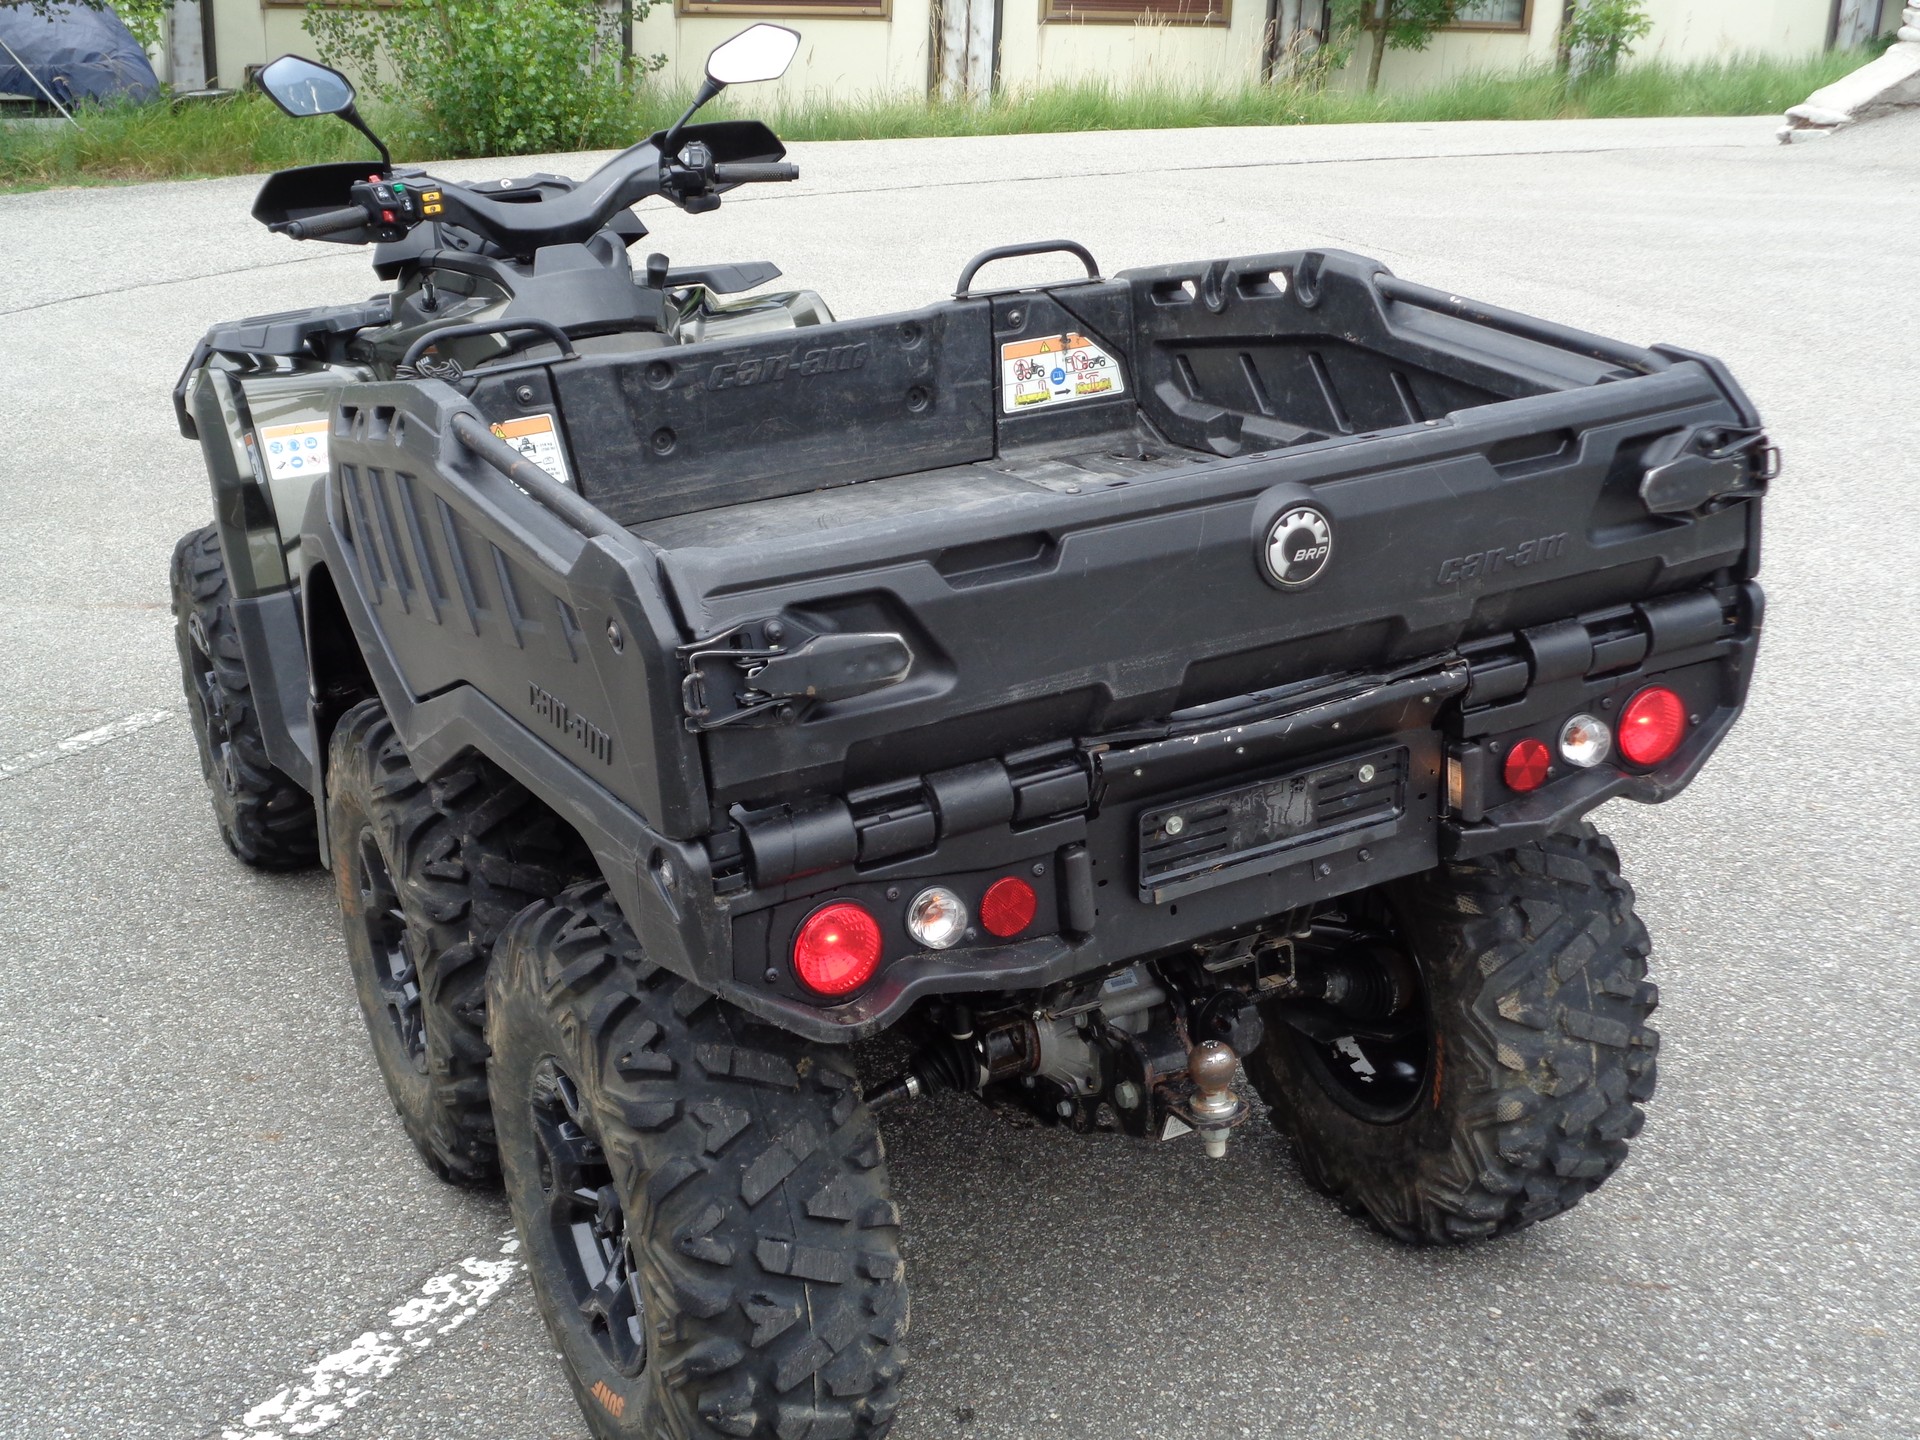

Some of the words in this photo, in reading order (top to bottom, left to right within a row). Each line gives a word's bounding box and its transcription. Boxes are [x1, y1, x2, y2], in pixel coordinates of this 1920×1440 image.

[706, 342, 868, 391] can-am
[1293, 545, 1328, 562] BRP
[1436, 532, 1568, 585] can-am
[527, 680, 612, 766] can-am
